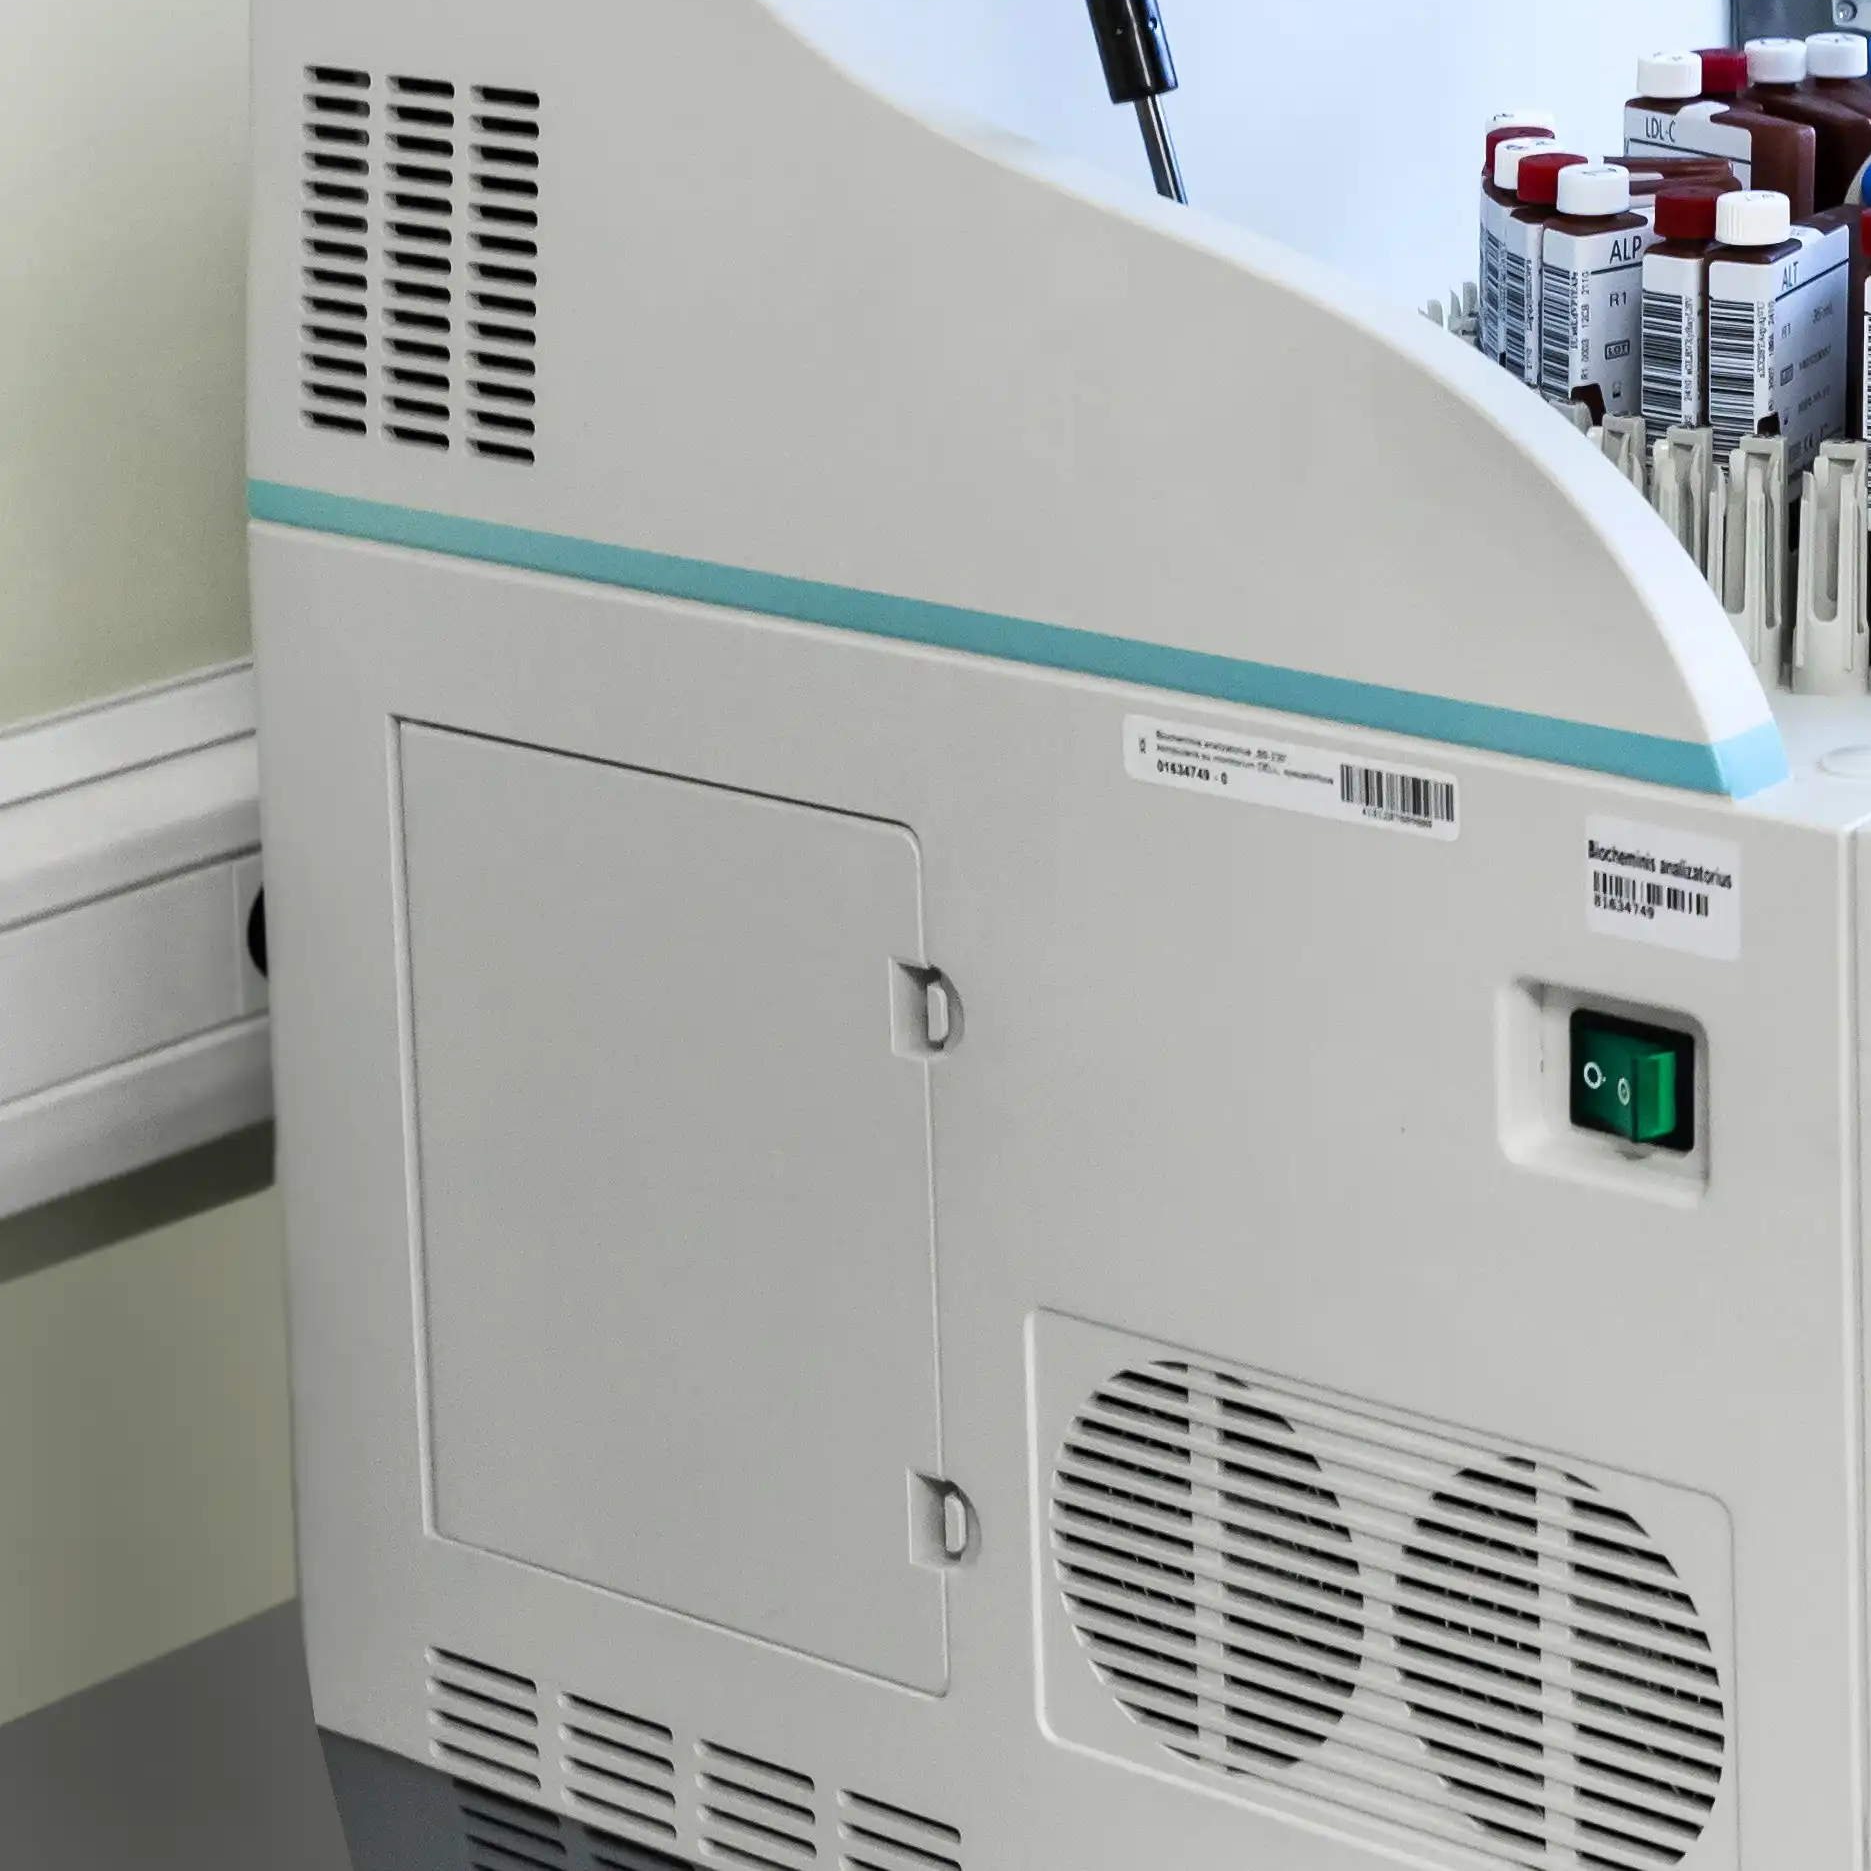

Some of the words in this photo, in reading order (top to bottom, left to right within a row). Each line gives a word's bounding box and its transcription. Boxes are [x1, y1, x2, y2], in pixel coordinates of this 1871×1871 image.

[1645, 115, 1676, 144] LDL-C
[1609, 235, 1642, 265] ALP
[1781, 260, 1799, 291] ALT
[1609, 291, 1628, 307] R1
